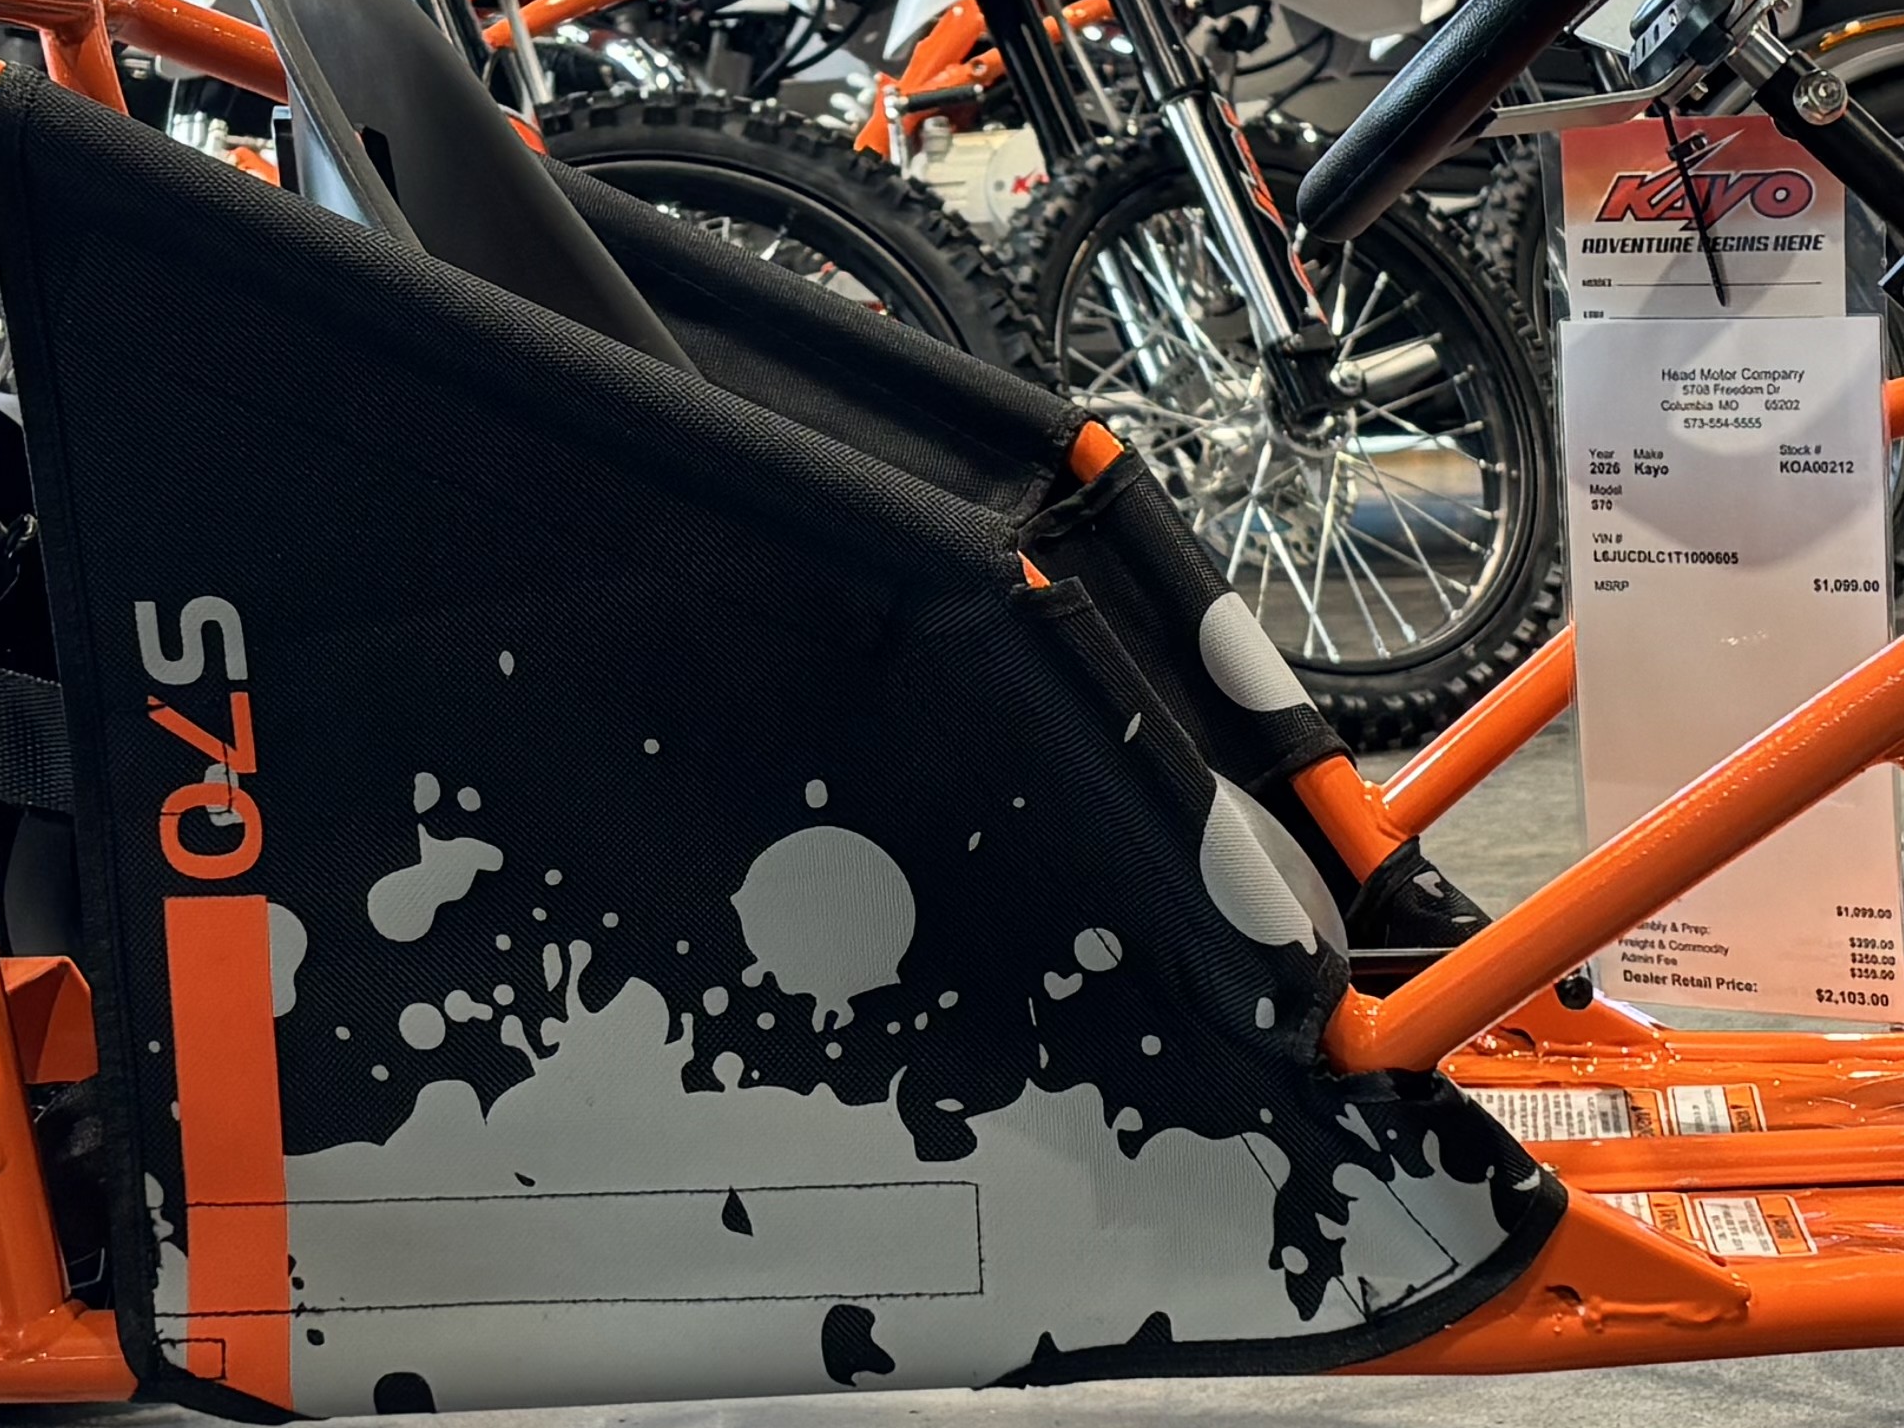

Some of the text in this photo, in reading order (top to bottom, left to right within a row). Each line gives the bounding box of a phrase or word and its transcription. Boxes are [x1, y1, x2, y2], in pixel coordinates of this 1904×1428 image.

[1595, 160, 1816, 230] KAYO
[1581, 237, 1693, 254] ADVENTURE
[1773, 234, 1825, 252] HERE
[1662, 369, 1805, 383] Head Motor Company
[1713, 384, 1764, 395] Freedom
[1767, 384, 1781, 395] Dr
[1661, 400, 1713, 411] Columbia
[1719, 400, 1739, 411] MO
[1589, 445, 1822, 460] Year Make Stock #
[1589, 462, 1621, 474] 2026
[1634, 464, 1669, 476] Kayo
[1590, 485, 1623, 496] Model
[1592, 533, 1613, 544] VIN
[1594, 579, 1880, 593] MSRP $1,099.00
[134, 595, 263, 880] S70
[1669, 940, 1730, 957] Commodity
[1621, 953, 1654, 966] Admin
[1656, 955, 1678, 967] Fee
[1624, 970, 1890, 1006] Dealer Retail Price: $2,103.00
